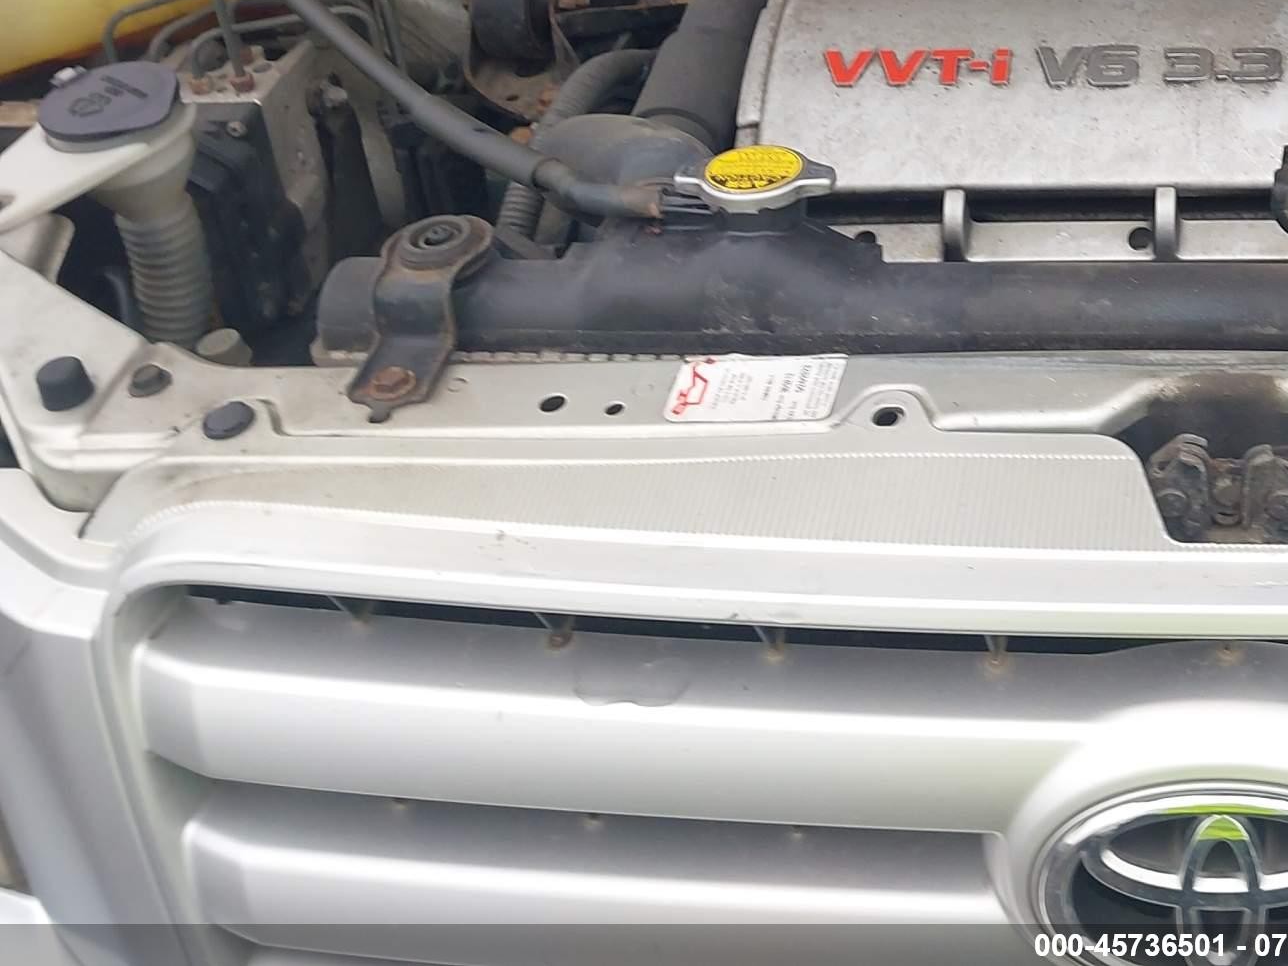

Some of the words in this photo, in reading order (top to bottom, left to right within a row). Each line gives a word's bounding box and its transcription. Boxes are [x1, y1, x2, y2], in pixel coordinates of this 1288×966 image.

[823, 48, 1012, 87] VVT-i
[1035, 44, 1141, 89] V6
[1162, 46, 1284, 85] 3.3
